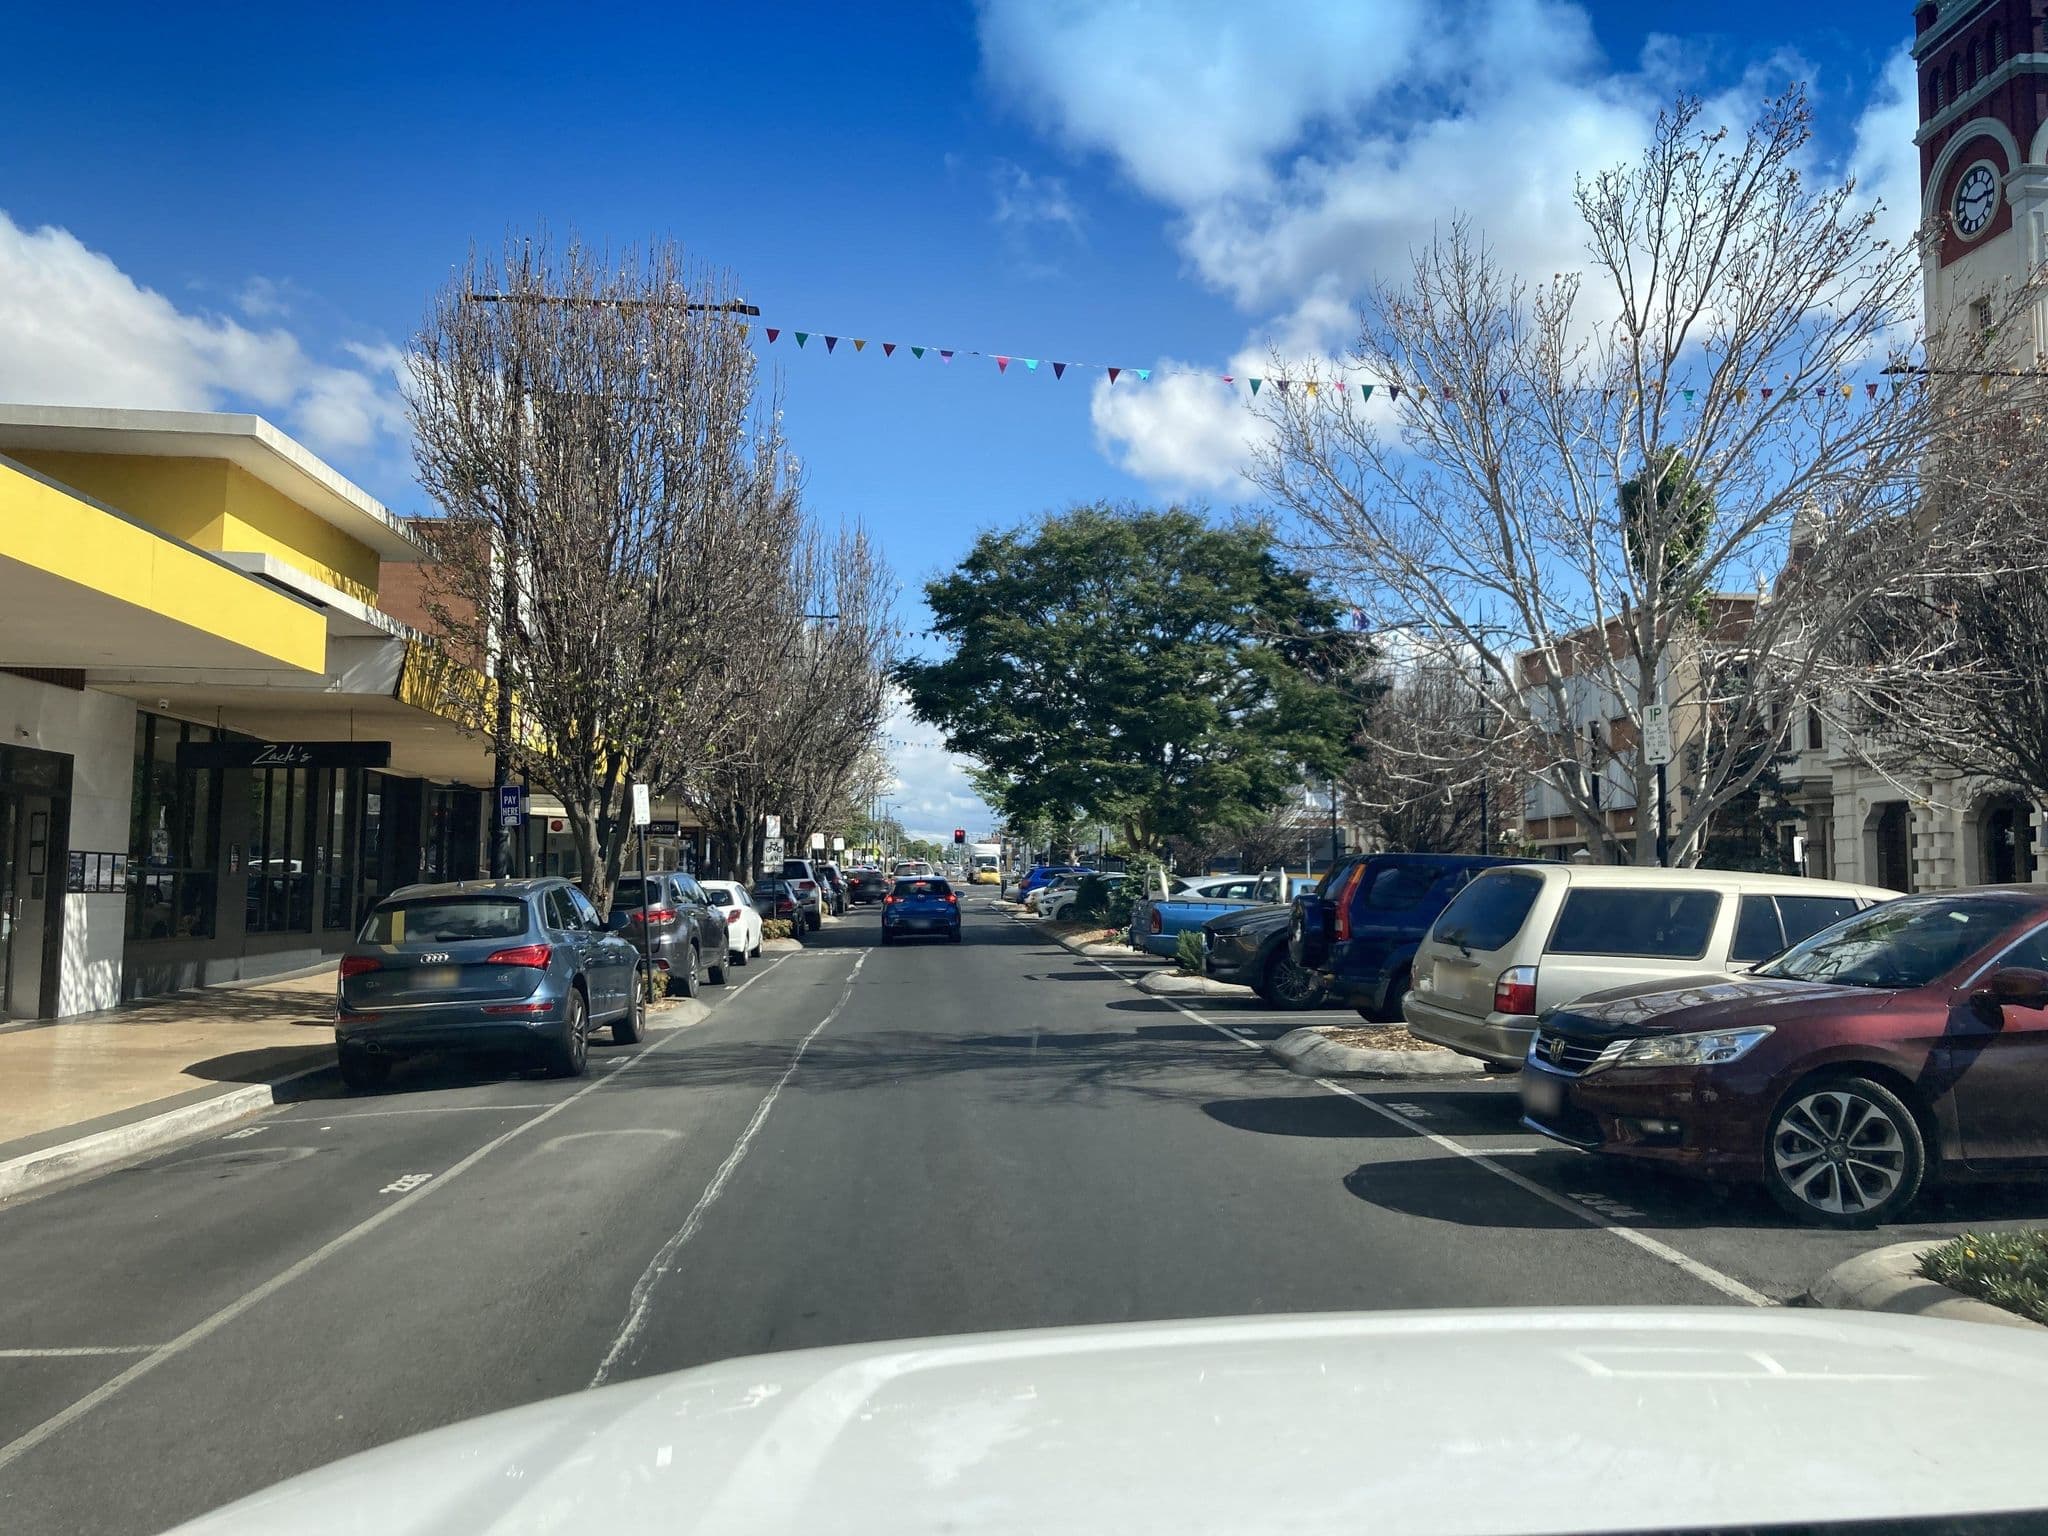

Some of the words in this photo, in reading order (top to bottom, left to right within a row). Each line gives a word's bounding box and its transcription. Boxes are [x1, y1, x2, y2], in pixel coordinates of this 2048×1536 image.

[1650, 708, 1662, 722] 1P
[252, 744, 313, 765] Zack's
[503, 795, 517, 805] PAY
[502, 807, 519, 816] HERE
[766, 855, 784, 863] LANE
